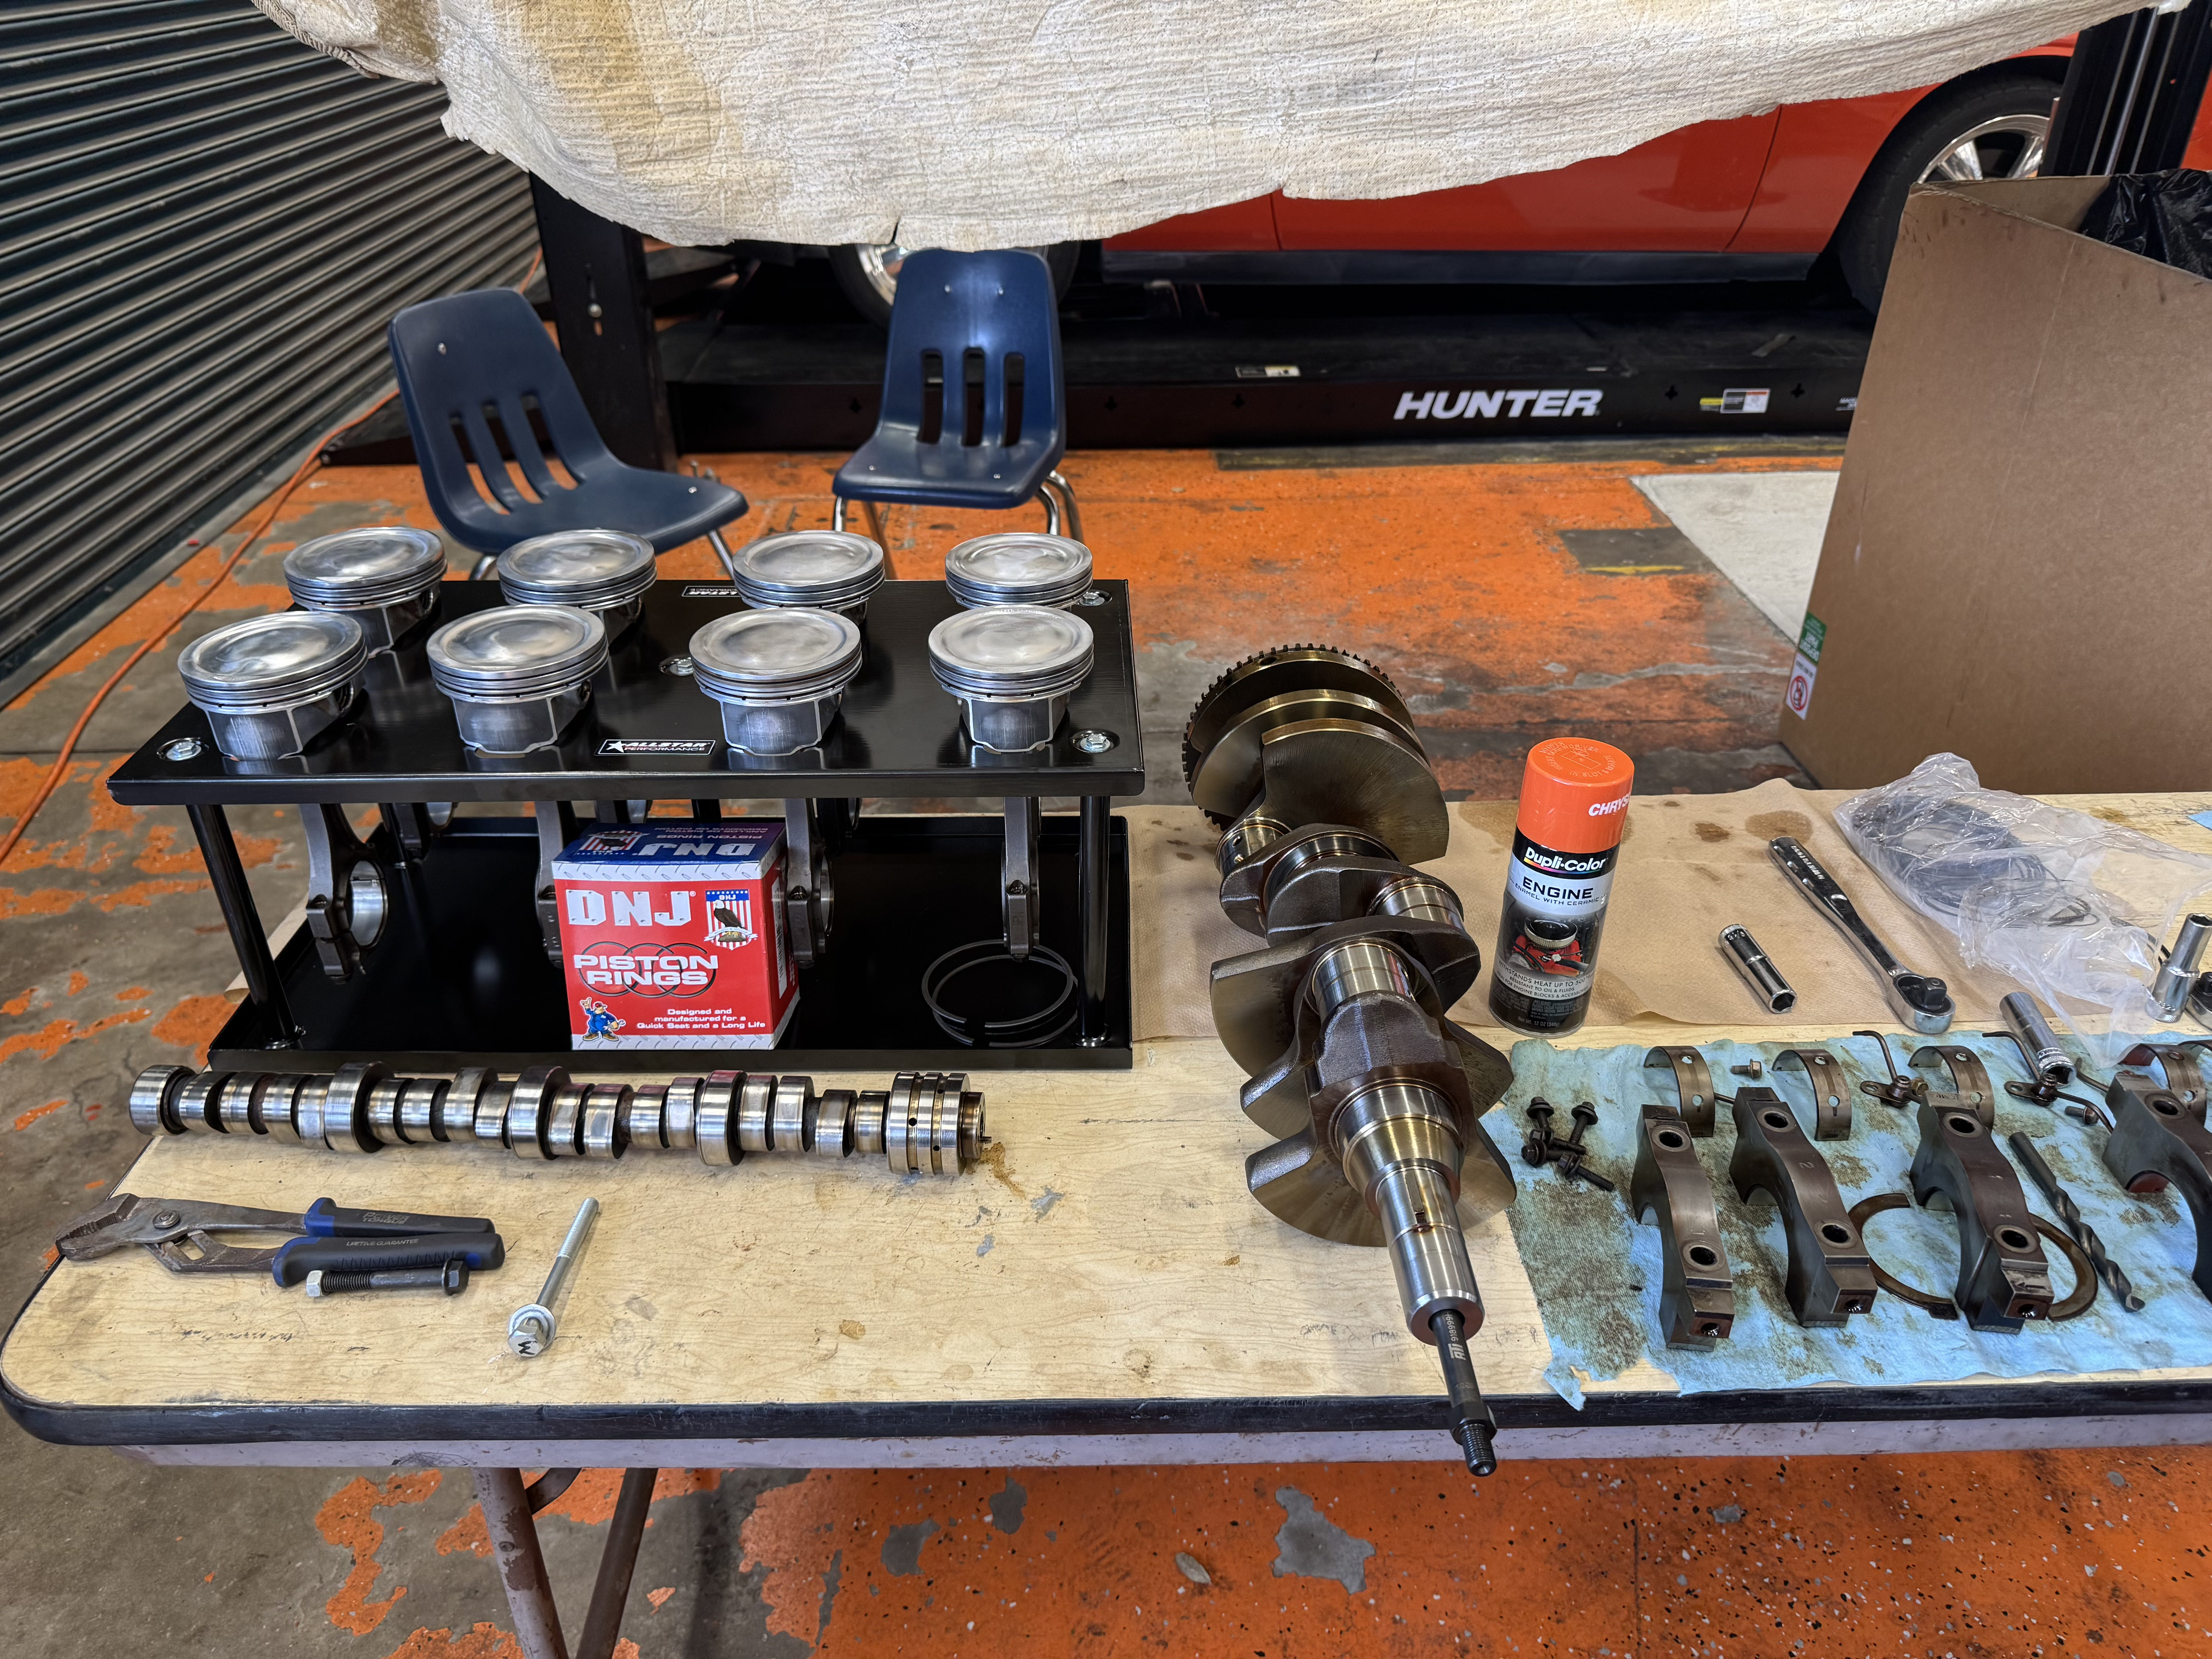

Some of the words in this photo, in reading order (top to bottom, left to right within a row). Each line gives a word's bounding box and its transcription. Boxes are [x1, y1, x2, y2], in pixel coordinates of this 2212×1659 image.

[1394, 389, 1603, 420] HUNTER
[1588, 792, 1631, 817] CHRYS
[638, 843, 756, 855] DNJ
[1515, 883, 1540, 900] ENAMEL
[1567, 896, 1599, 905] CERAMIC
[1522, 876, 1594, 899] ENGINE
[566, 890, 691, 926] DNJ
[574, 955, 718, 969] PISTON
[1499, 960, 1532, 983] WITHSTANDS
[587, 970, 708, 986] RINGS
[1510, 976, 1533, 989] RESISTANT
[1514, 984, 1533, 995] ENGINE
[362, 1212, 410, 1222] POWER
